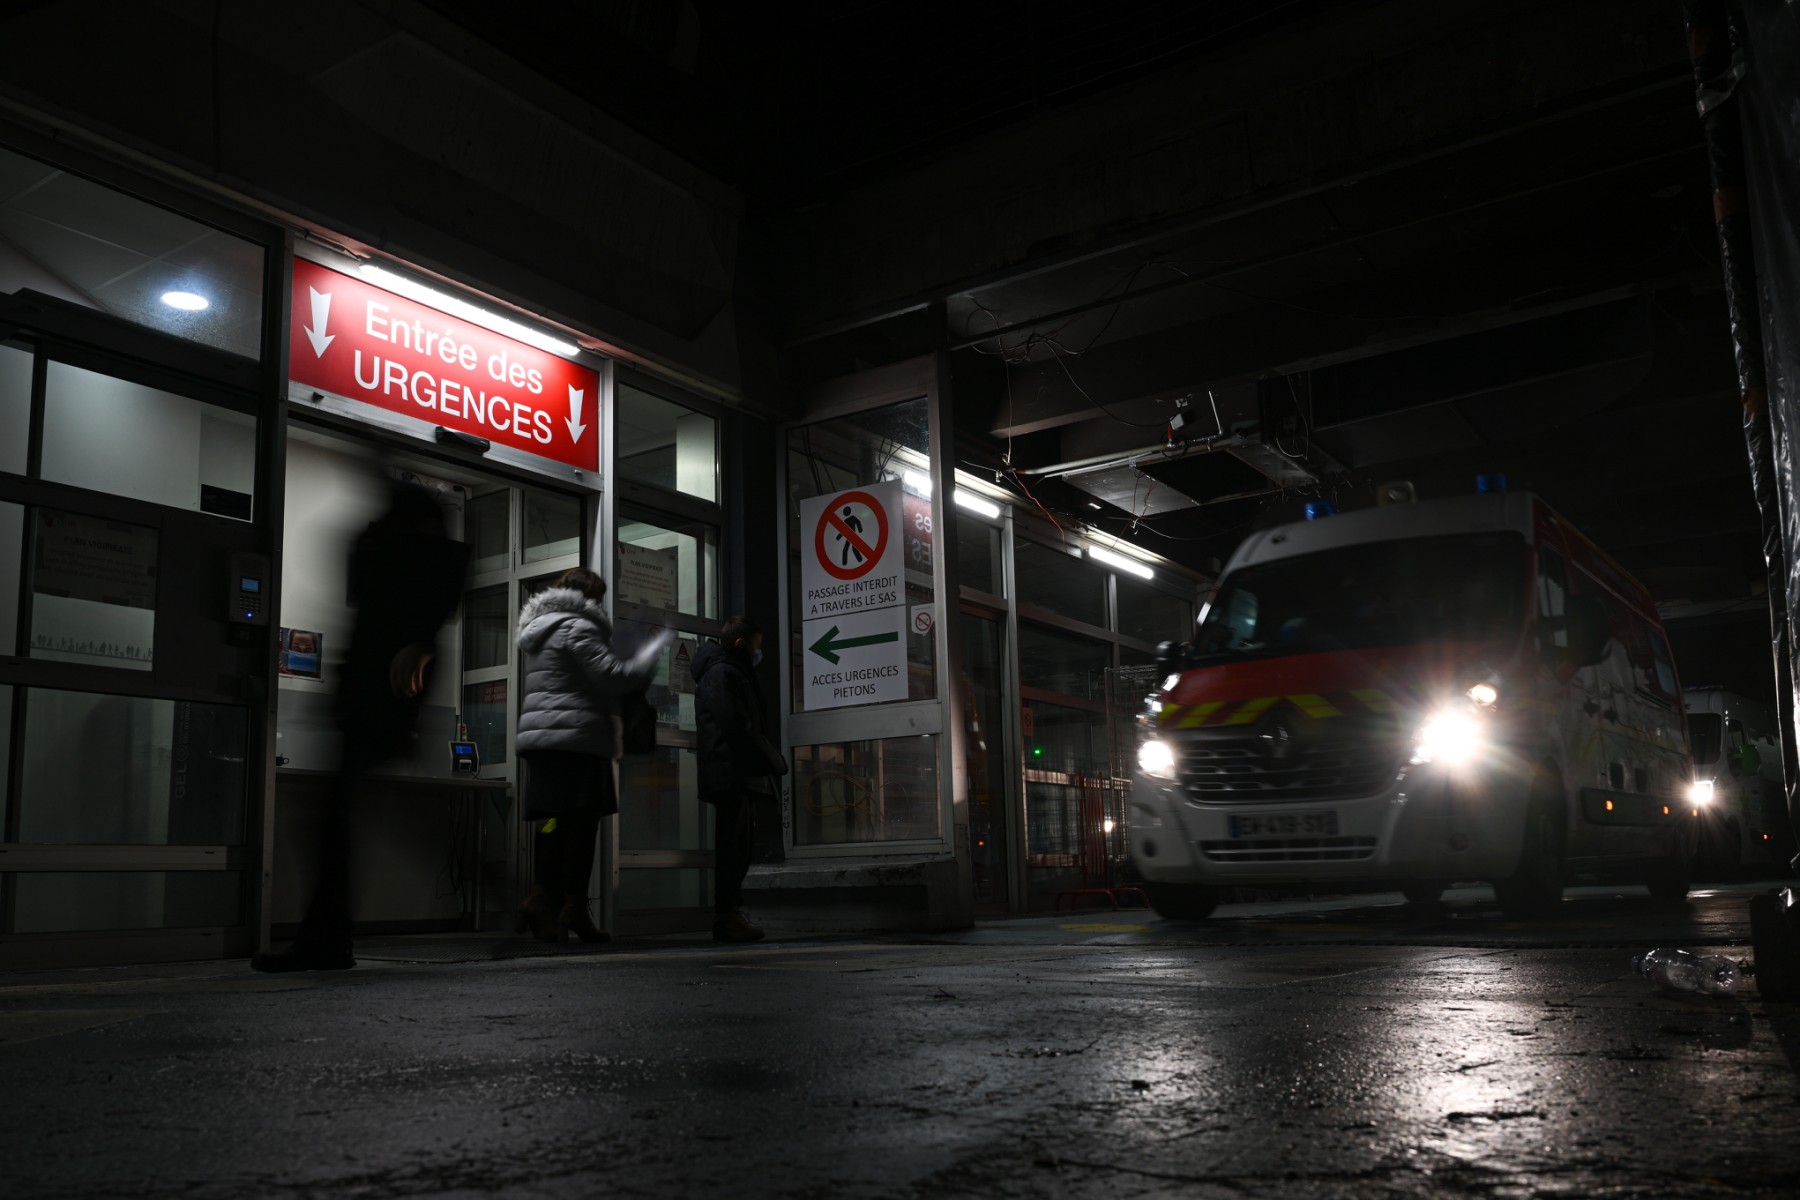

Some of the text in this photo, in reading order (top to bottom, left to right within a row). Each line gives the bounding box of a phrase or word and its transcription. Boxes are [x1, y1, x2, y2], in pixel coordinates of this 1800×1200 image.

[367, 301, 543, 394] Entrée des
[354, 350, 552, 444] URGENCES
[808, 576, 898, 600] PASSAGE INTERDIT
[811, 591, 897, 614] A TRAVERS LE SAS
[812, 665, 899, 686] ACCES URGENCES
[833, 684, 876, 699] PIETONS
